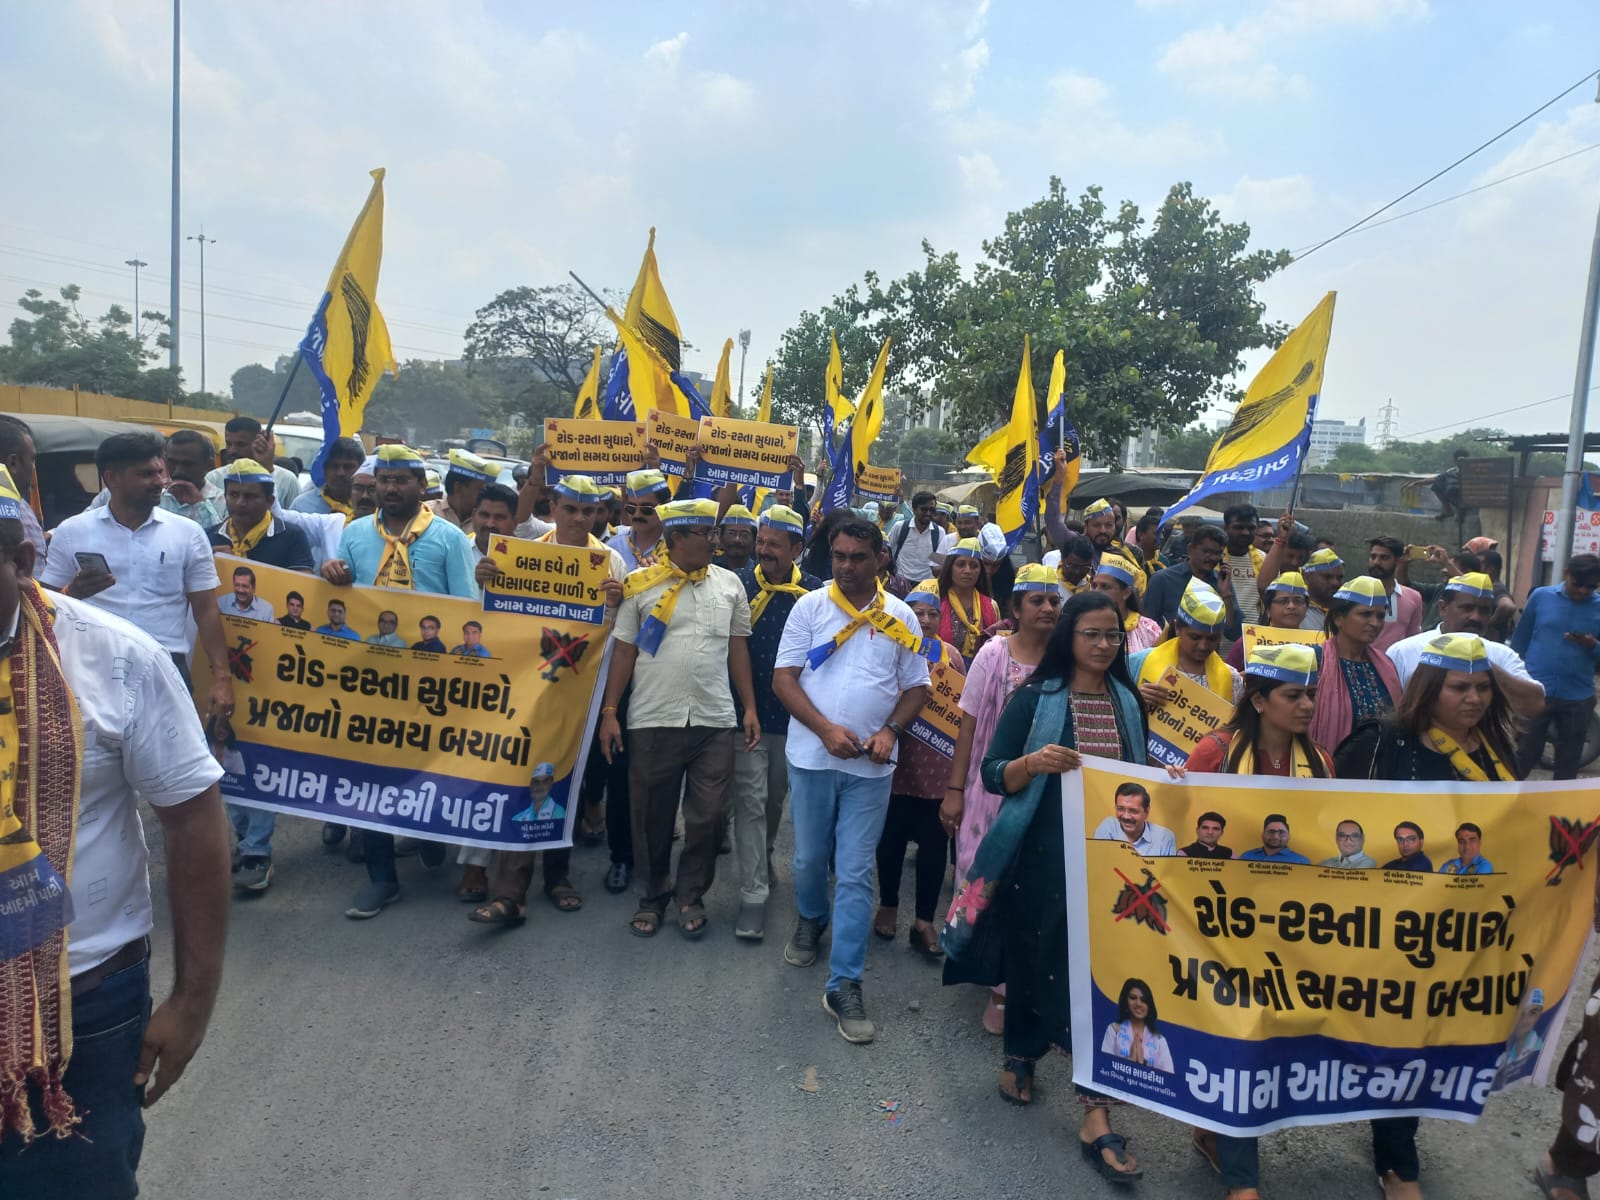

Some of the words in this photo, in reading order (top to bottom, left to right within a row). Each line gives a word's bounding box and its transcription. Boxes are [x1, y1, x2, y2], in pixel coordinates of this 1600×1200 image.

[557, 430, 601, 445] રોડ-રસ્તા
[603, 432, 636, 449] સુધારો,
[656, 422, 696, 440] રોડ-રસ્તા
[711, 427, 752, 443] રોડ-રસ્તા
[755, 435, 786, 449] સુધારો,
[549, 448, 580, 461] પ્રજાનો
[583, 451, 610, 463] સમય
[733, 449, 759, 461] સમય
[707, 468, 729, 480] આમ
[730, 472, 760, 485] આદમી
[761, 475, 781, 487] પાર્ટી
[516, 556, 541, 572] બસ
[545, 556, 563, 575] હવે
[566, 558, 580, 577] તો
[553, 581, 584, 598] વાળી
[587, 587, 600, 601] જ
[494, 599, 523, 613] આમ
[525, 602, 566, 617] આદમી
[569, 608, 594, 621] પાર્ટી
[277, 644, 409, 700] રોડ-રસ્તા
[418, 674, 516, 720] સુધારો,
[1168, 688, 1220, 729] રોડ-રસ્તા
[247, 696, 340, 738] પ્રજાનો
[347, 714, 429, 752] સમય
[439, 726, 531, 767] બચાવો
[911, 721, 932, 740] આમ
[253, 763, 327, 804] આમ
[334, 781, 438, 824] આદમી
[441, 792, 509, 833] પાર્ટી
[9, 868, 41, 889] આમ
[0, 888, 39, 915] આદમી
[1194, 881, 1380, 948] રોડ-રસ્તા
[1395, 895, 1515, 968] સુધારો,
[1169, 952, 1293, 1011] પ્રજાનો
[1296, 969, 1417, 1018] સમય
[1111, 1060, 1132, 1076] પાયલ
[1185, 1058, 1281, 1114] આમ
[1287, 1059, 1426, 1101] આદમી
